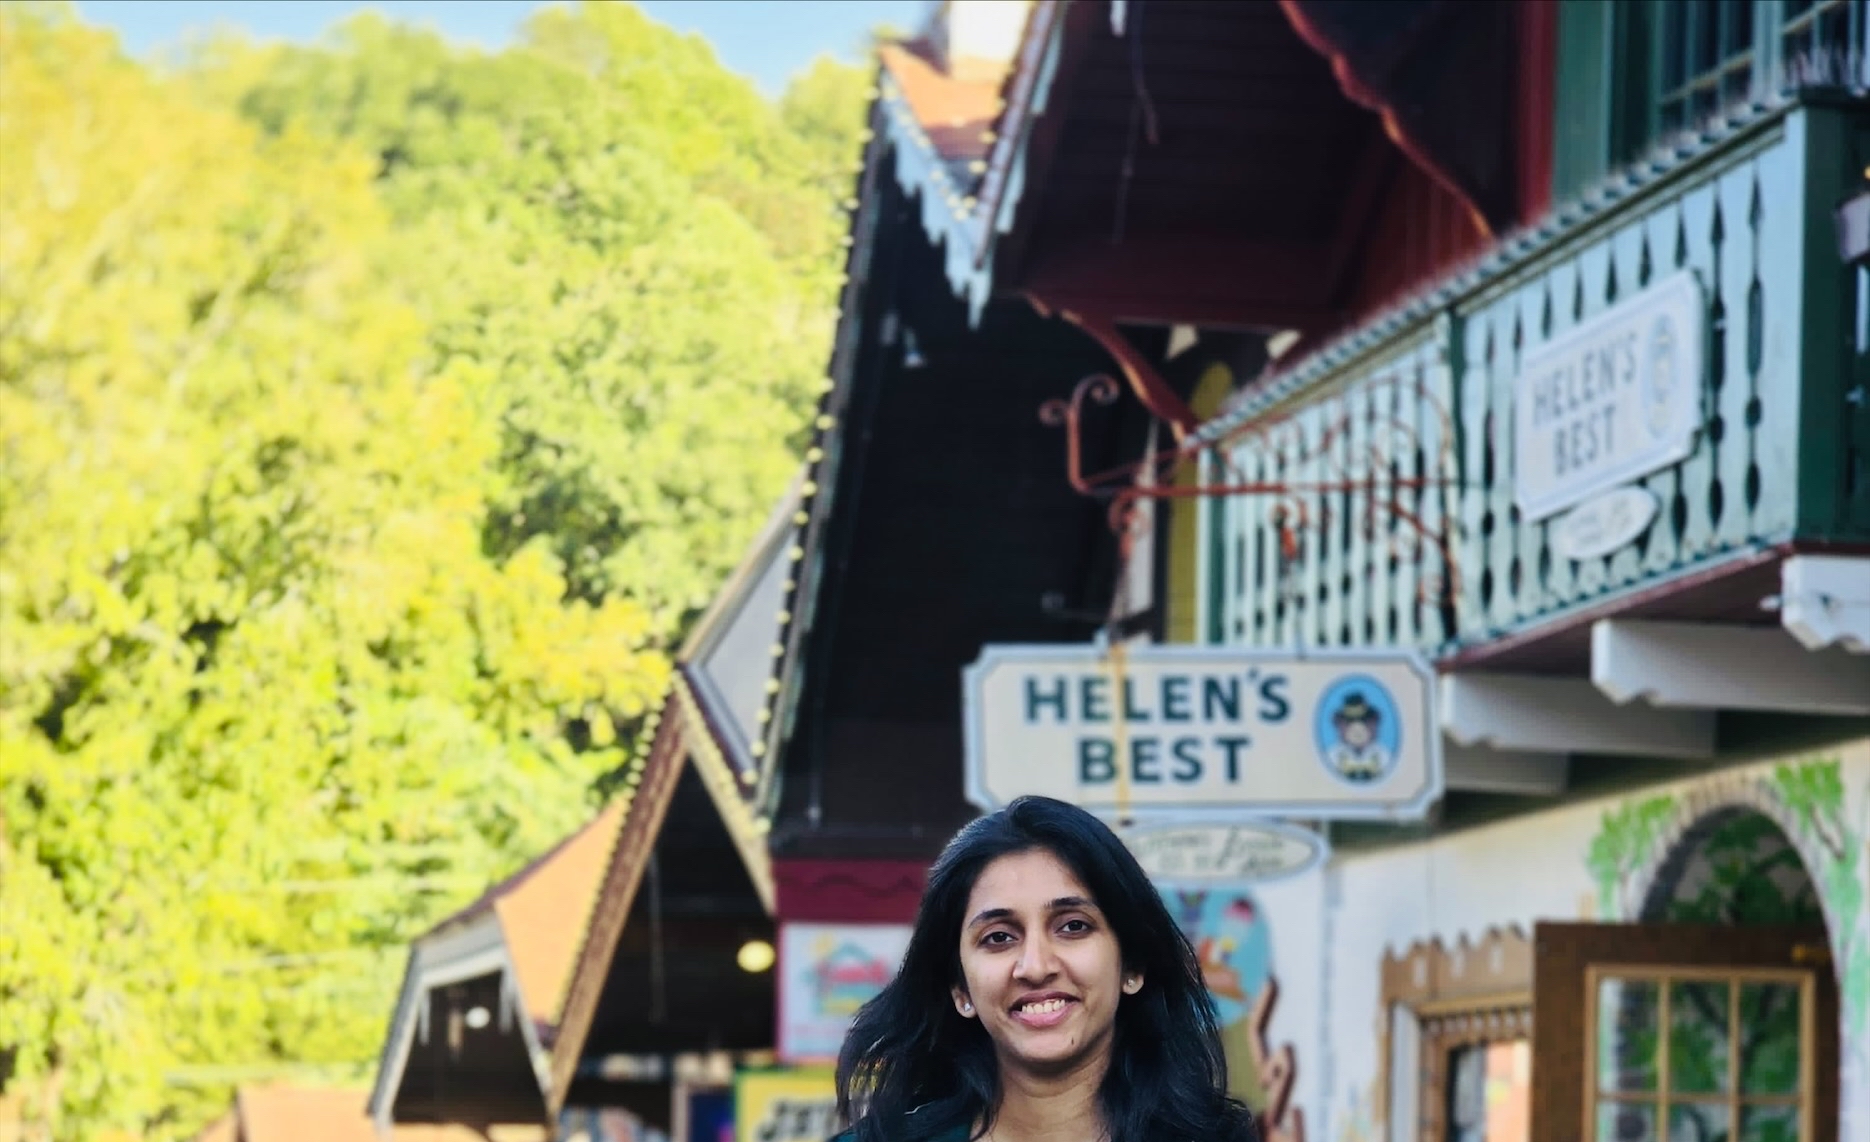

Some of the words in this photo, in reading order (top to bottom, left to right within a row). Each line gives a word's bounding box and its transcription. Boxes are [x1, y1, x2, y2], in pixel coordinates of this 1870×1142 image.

[1554, 402, 1616, 477] BEST
[1024, 667, 1292, 723] HELEN'S
[1077, 735, 1252, 784] BEST
